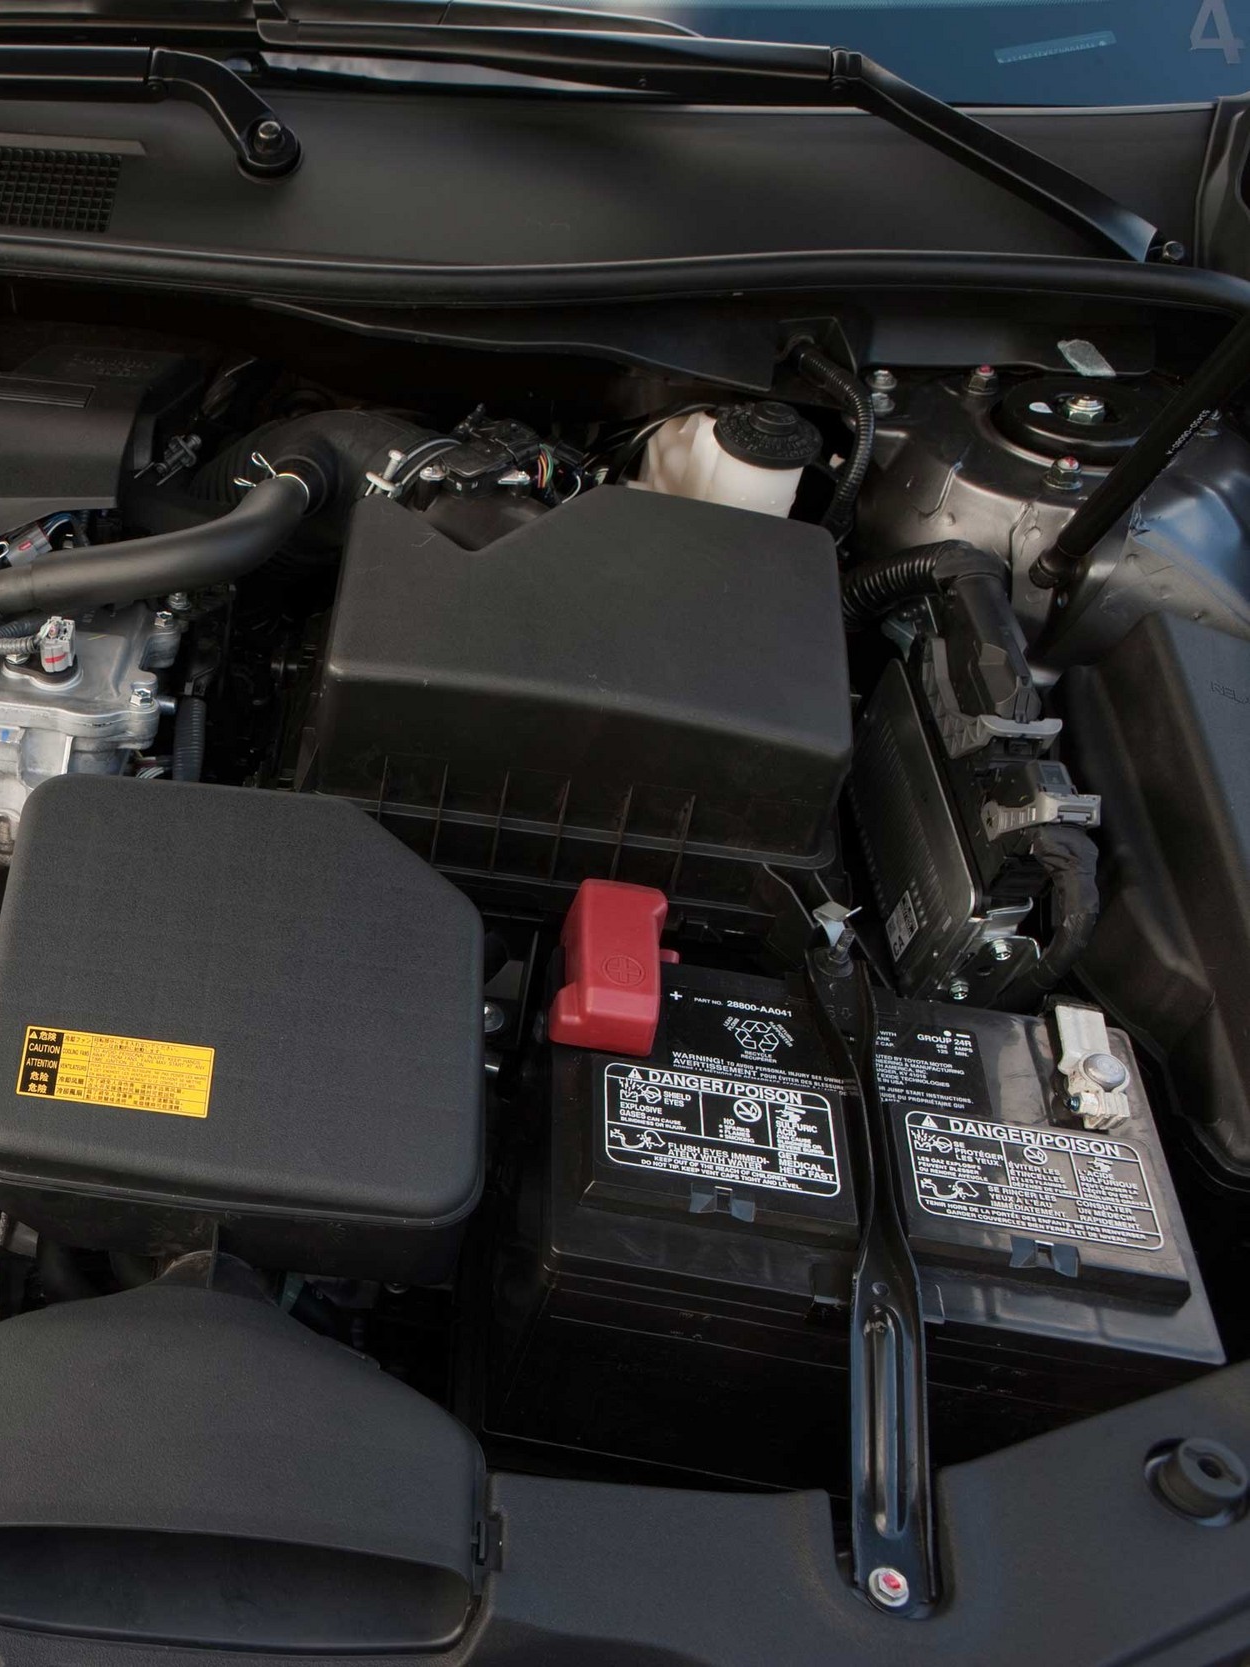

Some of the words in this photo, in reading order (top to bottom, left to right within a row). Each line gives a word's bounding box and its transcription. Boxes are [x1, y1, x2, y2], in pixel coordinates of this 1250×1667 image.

[694, 997, 711, 1005] PART
[727, 1000, 793, 1018] 28800-AA041
[917, 1034, 952, 1044] GROUP
[954, 1039, 972, 1048] 24R
[29, 1043, 61, 1055] CAUTION
[63, 1048, 79, 1056] COOLING
[744, 1050, 773, 1059] RECYCLE
[954, 1046, 973, 1054] AMPS
[26, 1058, 58, 1070] ATTENTION
[673, 1051, 724, 1065] WARNING!
[736, 1062, 755, 1070] AVOID
[755, 1066, 787, 1076] PERSONAL
[788, 1071, 810, 1079] INJURY
[673, 1058, 758, 1077] AVERTISSEMENT
[904, 1058, 930, 1066] TOYOTA
[930, 1061, 953, 1069] MOTOR
[910, 1064, 965, 1076] MANUFACTURING
[649, 1071, 802, 1105] DANGER/POISON
[901, 1076, 951, 1088] TECHNOLOGIES
[663, 1091, 691, 1102] SHIELD
[664, 1099, 685, 1108] EYES
[620, 1102, 663, 1115] EXPLOSIVE
[620, 1110, 646, 1120] GASES
[661, 1118, 682, 1126] CAUSE
[723, 1118, 735, 1126] NO
[776, 1120, 818, 1134] SULFURIC
[777, 1128, 797, 1137] ACID
[949, 1119, 1121, 1157] DANGER/POISON
[954, 1141, 966, 1149] SE
[668, 1142, 701, 1154] FLUSH
[703, 1148, 729, 1158] EYES
[732, 1153, 770, 1165] IMMEDI-
[668, 1149, 699, 1161] ATELY
[701, 1154, 725, 1164] WITH
[728, 1159, 763, 1171] WATER
[778, 1151, 799, 1161] GET
[954, 1148, 1004, 1161] PROTÉGER
[779, 1159, 825, 1173] MEDICAL
[946, 1160, 982, 1171] EXPLOSIFS
[956, 1155, 973, 1163] LES
[976, 1158, 1002, 1167] YEUX.
[715, 1166, 740, 1175] REACH
[780, 1166, 807, 1177] HELP
[808, 1171, 835, 1181] FAST
[918, 1162, 948, 1170] PEUVENT
[949, 1166, 979, 1175] BLESSER
[931, 1168, 957, 1177] RENDRE
[958, 1173, 989, 1182] AVEUGLE
[1009, 1162, 1041, 1174] ÉVITER
[1043, 1167, 1061, 1176] LES
[702, 1169, 719, 1177] VENT
[721, 1172, 740, 1180] CAPS
[741, 1175, 762, 1184] TIGHT
[779, 1181, 803, 1190] LEVEL.
[1010, 1169, 1066, 1184] ÉTINCELLES
[1080, 1176, 1139, 1190] SULFURIQUE
[1002, 1187, 1038, 1199] RINCER
[1039, 1194, 1057, 1202] LES
[1012, 1182, 1044, 1192] DÉFENSE
[1055, 1189, 1079, 1197] FUMER
[1100, 1185, 1129, 1194] CAUSER
[990, 1194, 1014, 1202] YEUX
[1025, 1199, 1053, 1209] L'EAU
[1076, 1201, 1133, 1215] CONSULTER
[925, 1200, 946, 1208] TENIR
[948, 1204, 968, 1212] HORS
[992, 1210, 1020, 1219] PORTÉE
[1078, 1208, 1092, 1216] UN
[1094, 1209, 1136, 1222] MÉDECIN
[946, 1209, 976, 1219] GARDER
[978, 1214, 1026, 1226] COUVERCLES
[1028, 1222, 1044, 1230] BIEN
[1046, 1225, 1076, 1235] FERMÉS
[1080, 1215, 1142, 1230] RAPIDEMENT.
